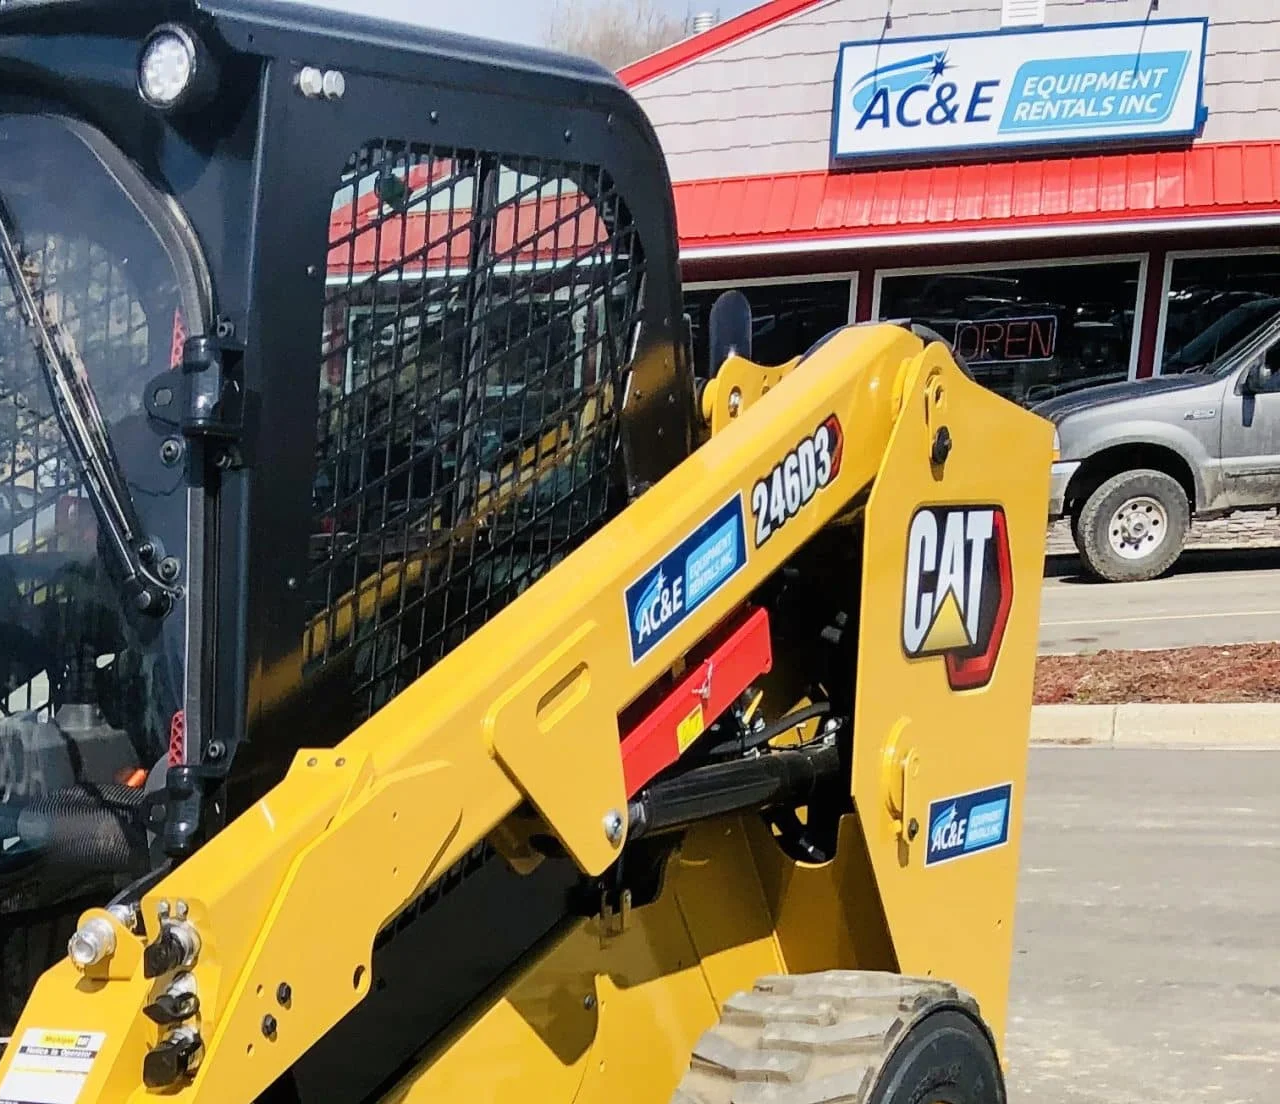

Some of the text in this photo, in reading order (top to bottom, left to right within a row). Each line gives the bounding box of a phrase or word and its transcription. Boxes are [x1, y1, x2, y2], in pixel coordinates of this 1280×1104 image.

[855, 79, 1001, 131] AC&E
[1022, 67, 1169, 98] EQUIPMENT
[1013, 92, 1163, 122] RENTALS INC
[958, 320, 1054, 360] OPEN
[752, 425, 831, 545] 246D3
[903, 509, 994, 653] CAT
[637, 576, 684, 644] AC&E
[931, 818, 967, 853] AC&E
